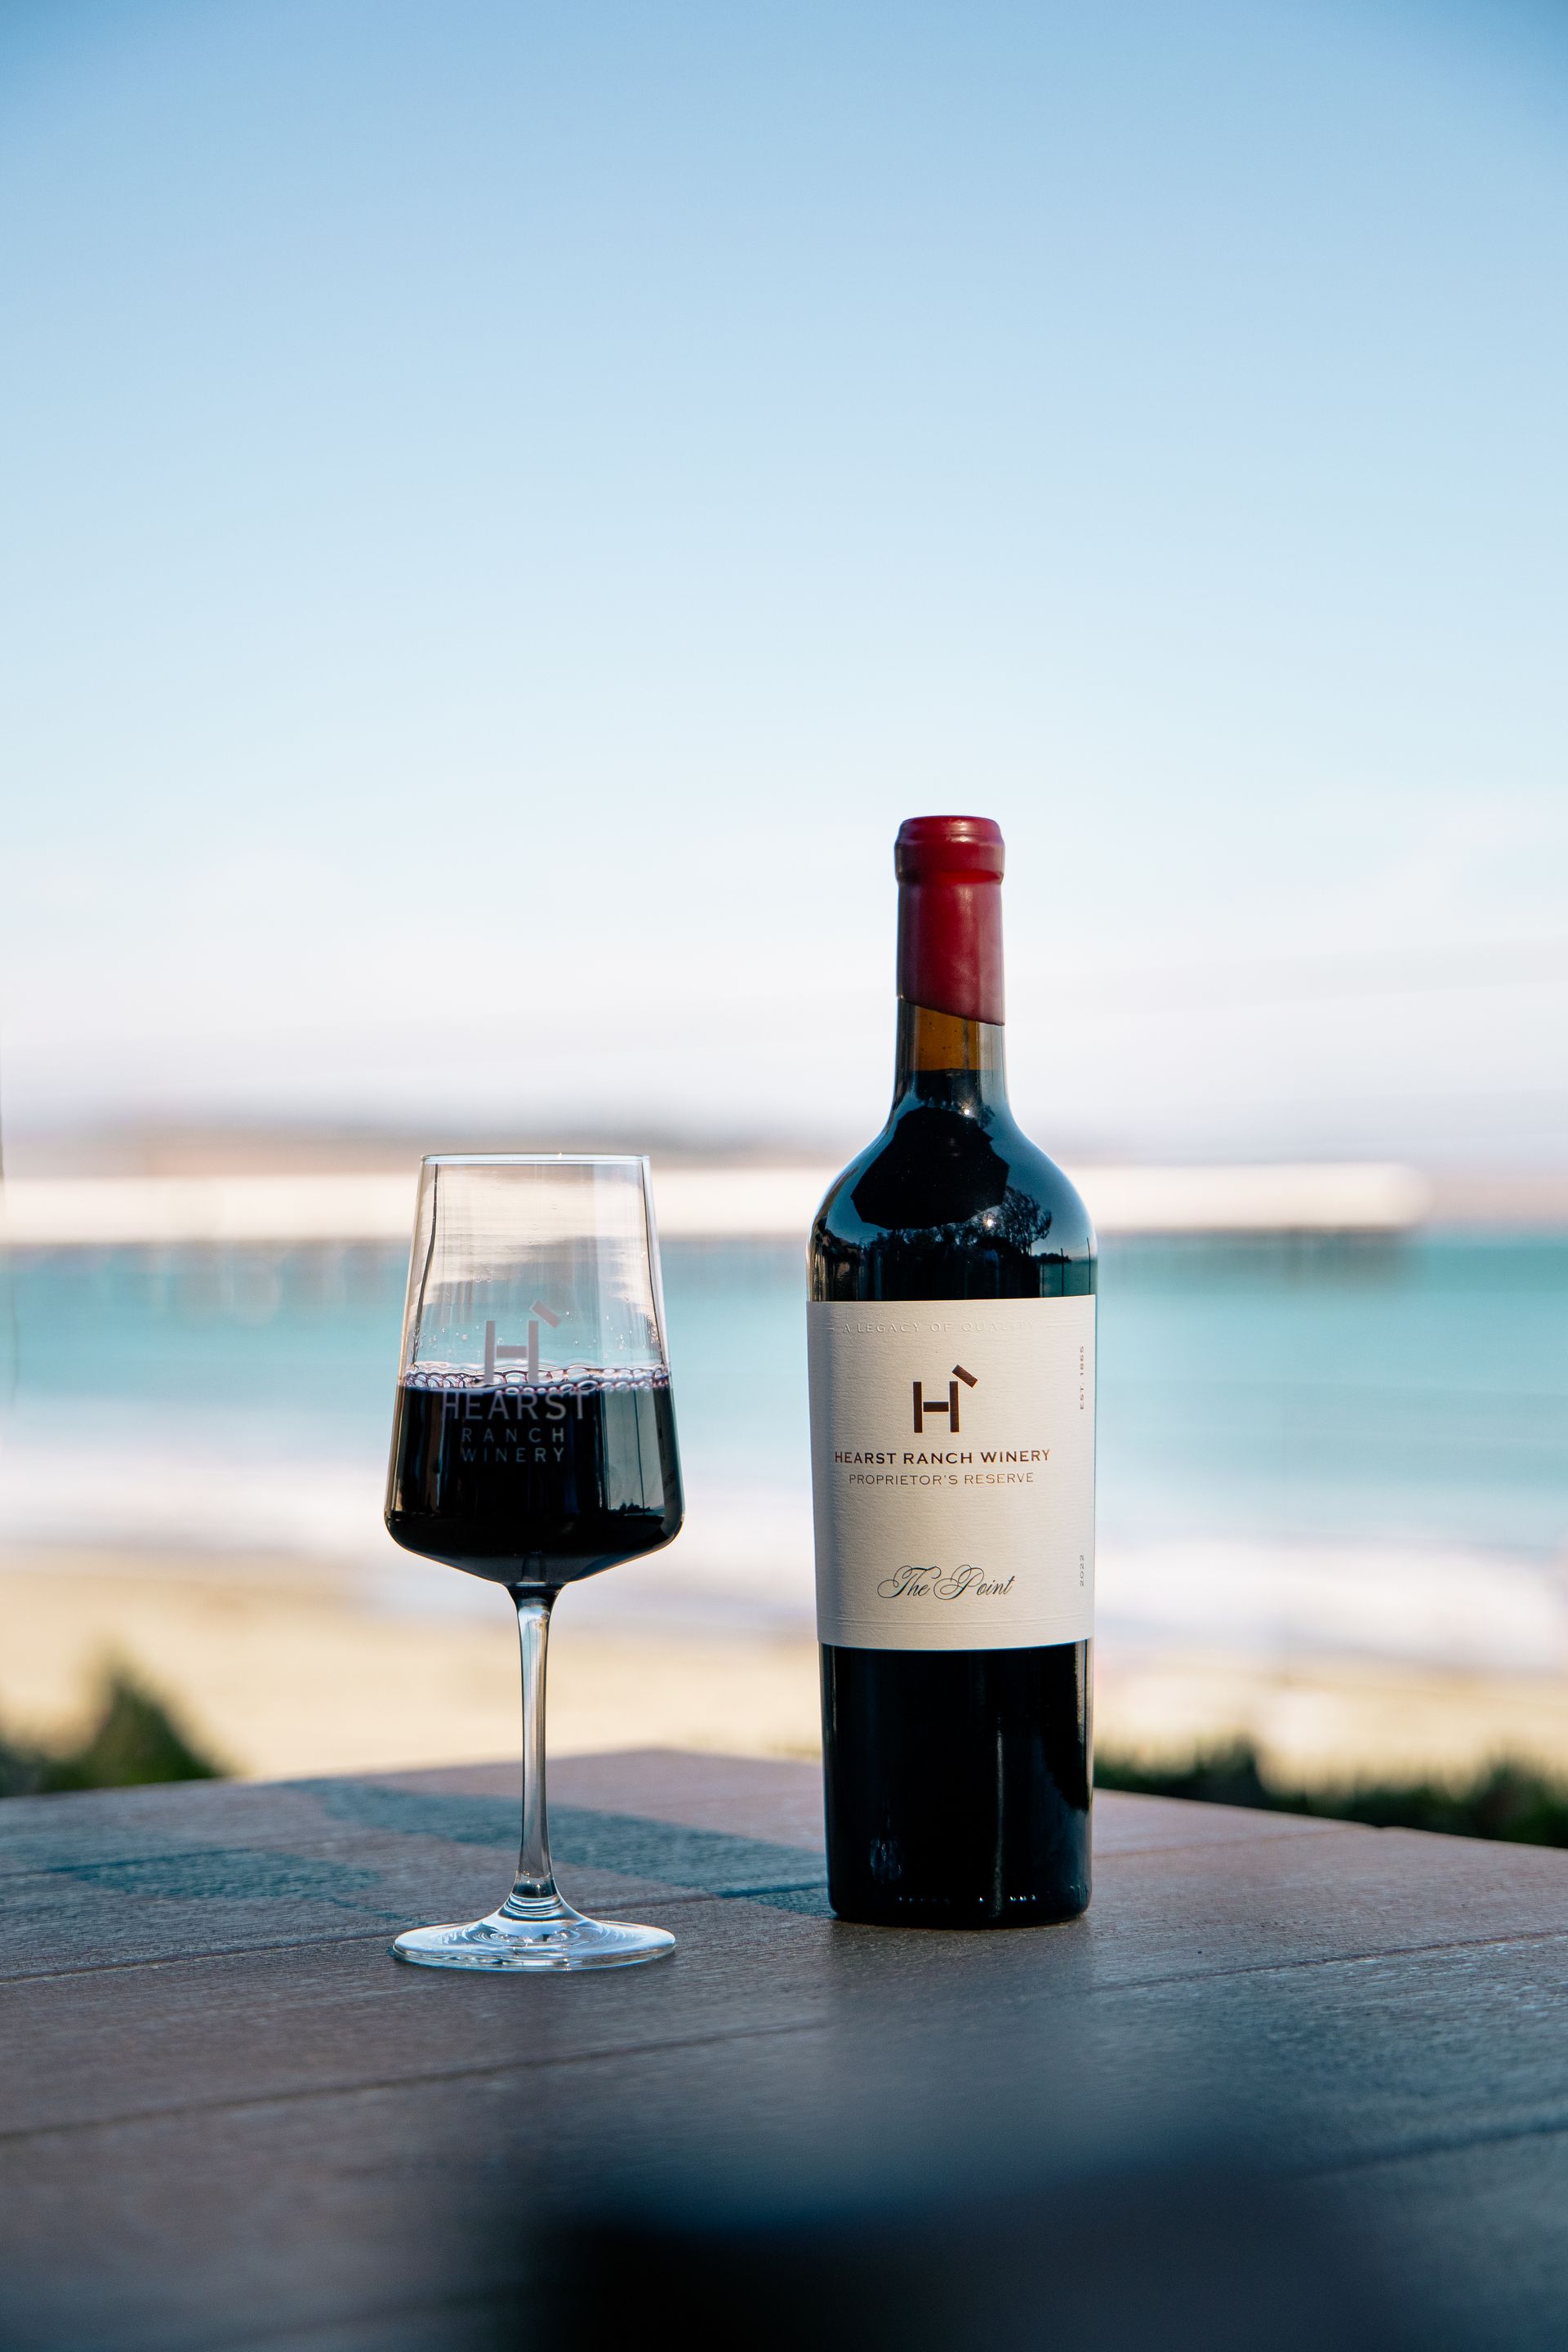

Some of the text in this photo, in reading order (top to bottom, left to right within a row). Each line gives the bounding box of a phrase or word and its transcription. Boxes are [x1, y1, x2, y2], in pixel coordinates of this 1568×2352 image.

[842, 1320, 1033, 1333] A LEGACY OF QUALTY
[442, 1390, 590, 1420] HEARST
[461, 1428, 565, 1443] RANCH
[461, 1447, 565, 1463] WINERY
[834, 1449, 1051, 1464] HEARST RANCH WINERY
[849, 1472, 1034, 1486] PROPRIETOR'S RESERVE
[876, 1564, 1016, 1601] The Point
